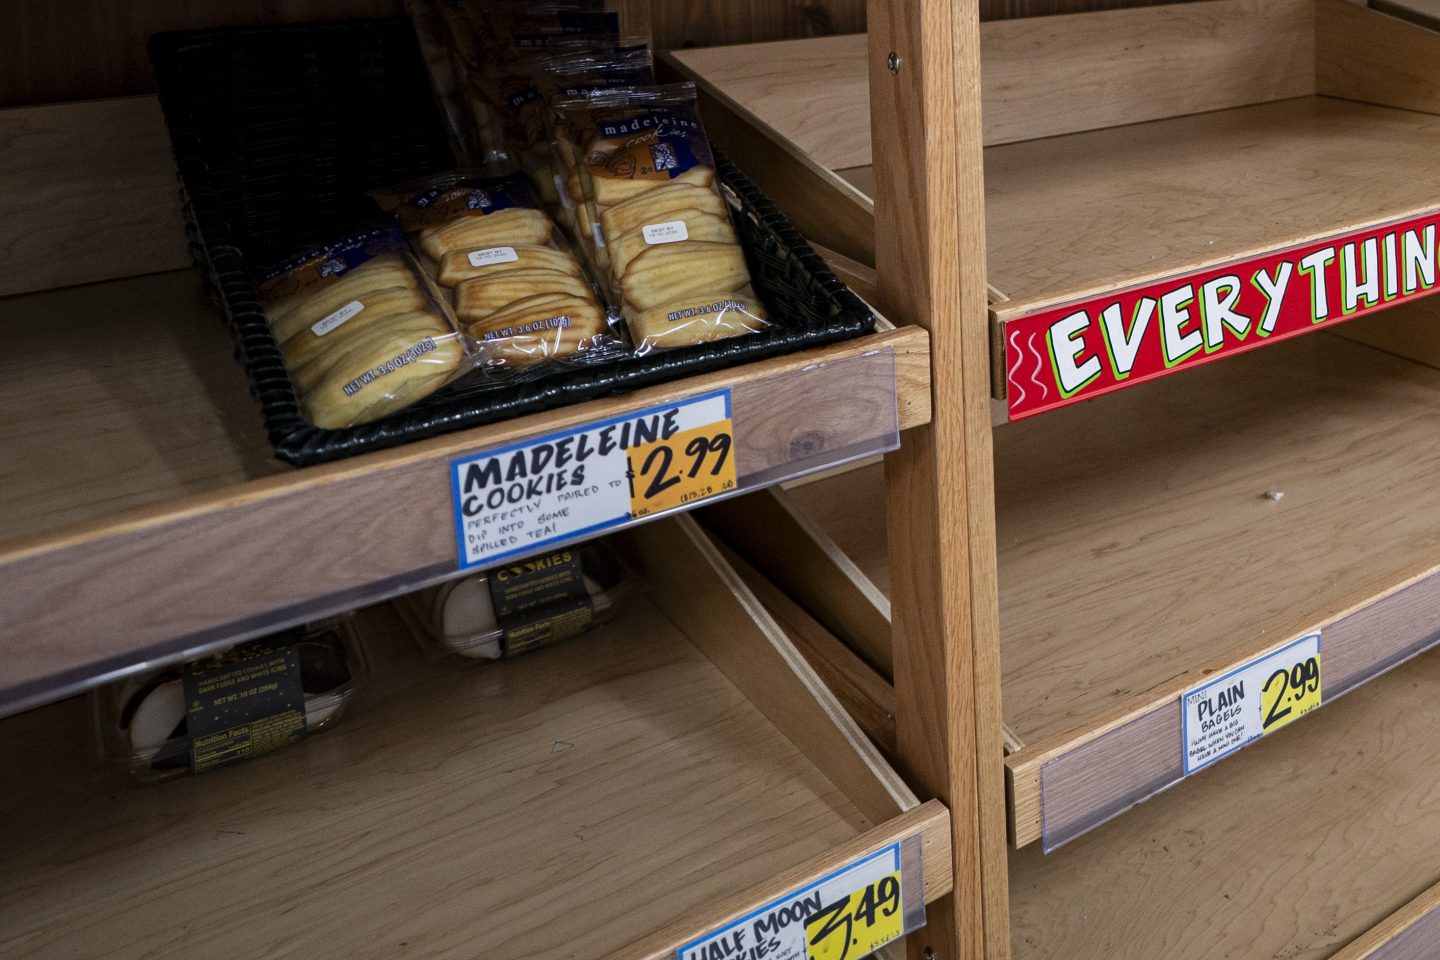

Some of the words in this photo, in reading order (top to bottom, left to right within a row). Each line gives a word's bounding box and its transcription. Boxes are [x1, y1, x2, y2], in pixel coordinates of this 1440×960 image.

[604, 114, 698, 136] madeleine
[668, 312, 683, 322] NET
[699, 305, 712, 315] 3.6
[712, 302, 723, 312] OZ
[484, 330, 500, 341] NET
[518, 323, 531, 334] 3.6
[532, 320, 543, 331] OZ
[343, 378, 362, 397] NET
[378, 359, 394, 377] 3.6
[393, 352, 408, 369] OZ
[463, 408, 680, 493] MADELEINE
[461, 464, 586, 518] COOKIES
[468, 499, 542, 530] PERFECTLY
[557, 486, 599, 503] PAIRED
[609, 479, 622, 488] TO
[468, 531, 487, 544] DIP
[498, 521, 525, 536] INTO
[537, 507, 570, 523] SOME
[471, 535, 518, 556] SPILLED
[497, 551, 573, 582] COOKIES
[250, 669, 270, 681] WHITE
[213, 695, 227, 706] NET
[248, 687, 258, 696] OZ
[1187, 690, 1207, 707] MINI
[1197, 680, 1245, 722] PLAIN
[1201, 704, 1242, 733] BAGELS
[195, 732, 228, 747] Nutrition
[228, 726, 250, 738] Facts
[1208, 737, 1225, 749] WHEN
[690, 928, 746, 960] HALF
[753, 891, 822, 941] MOON
